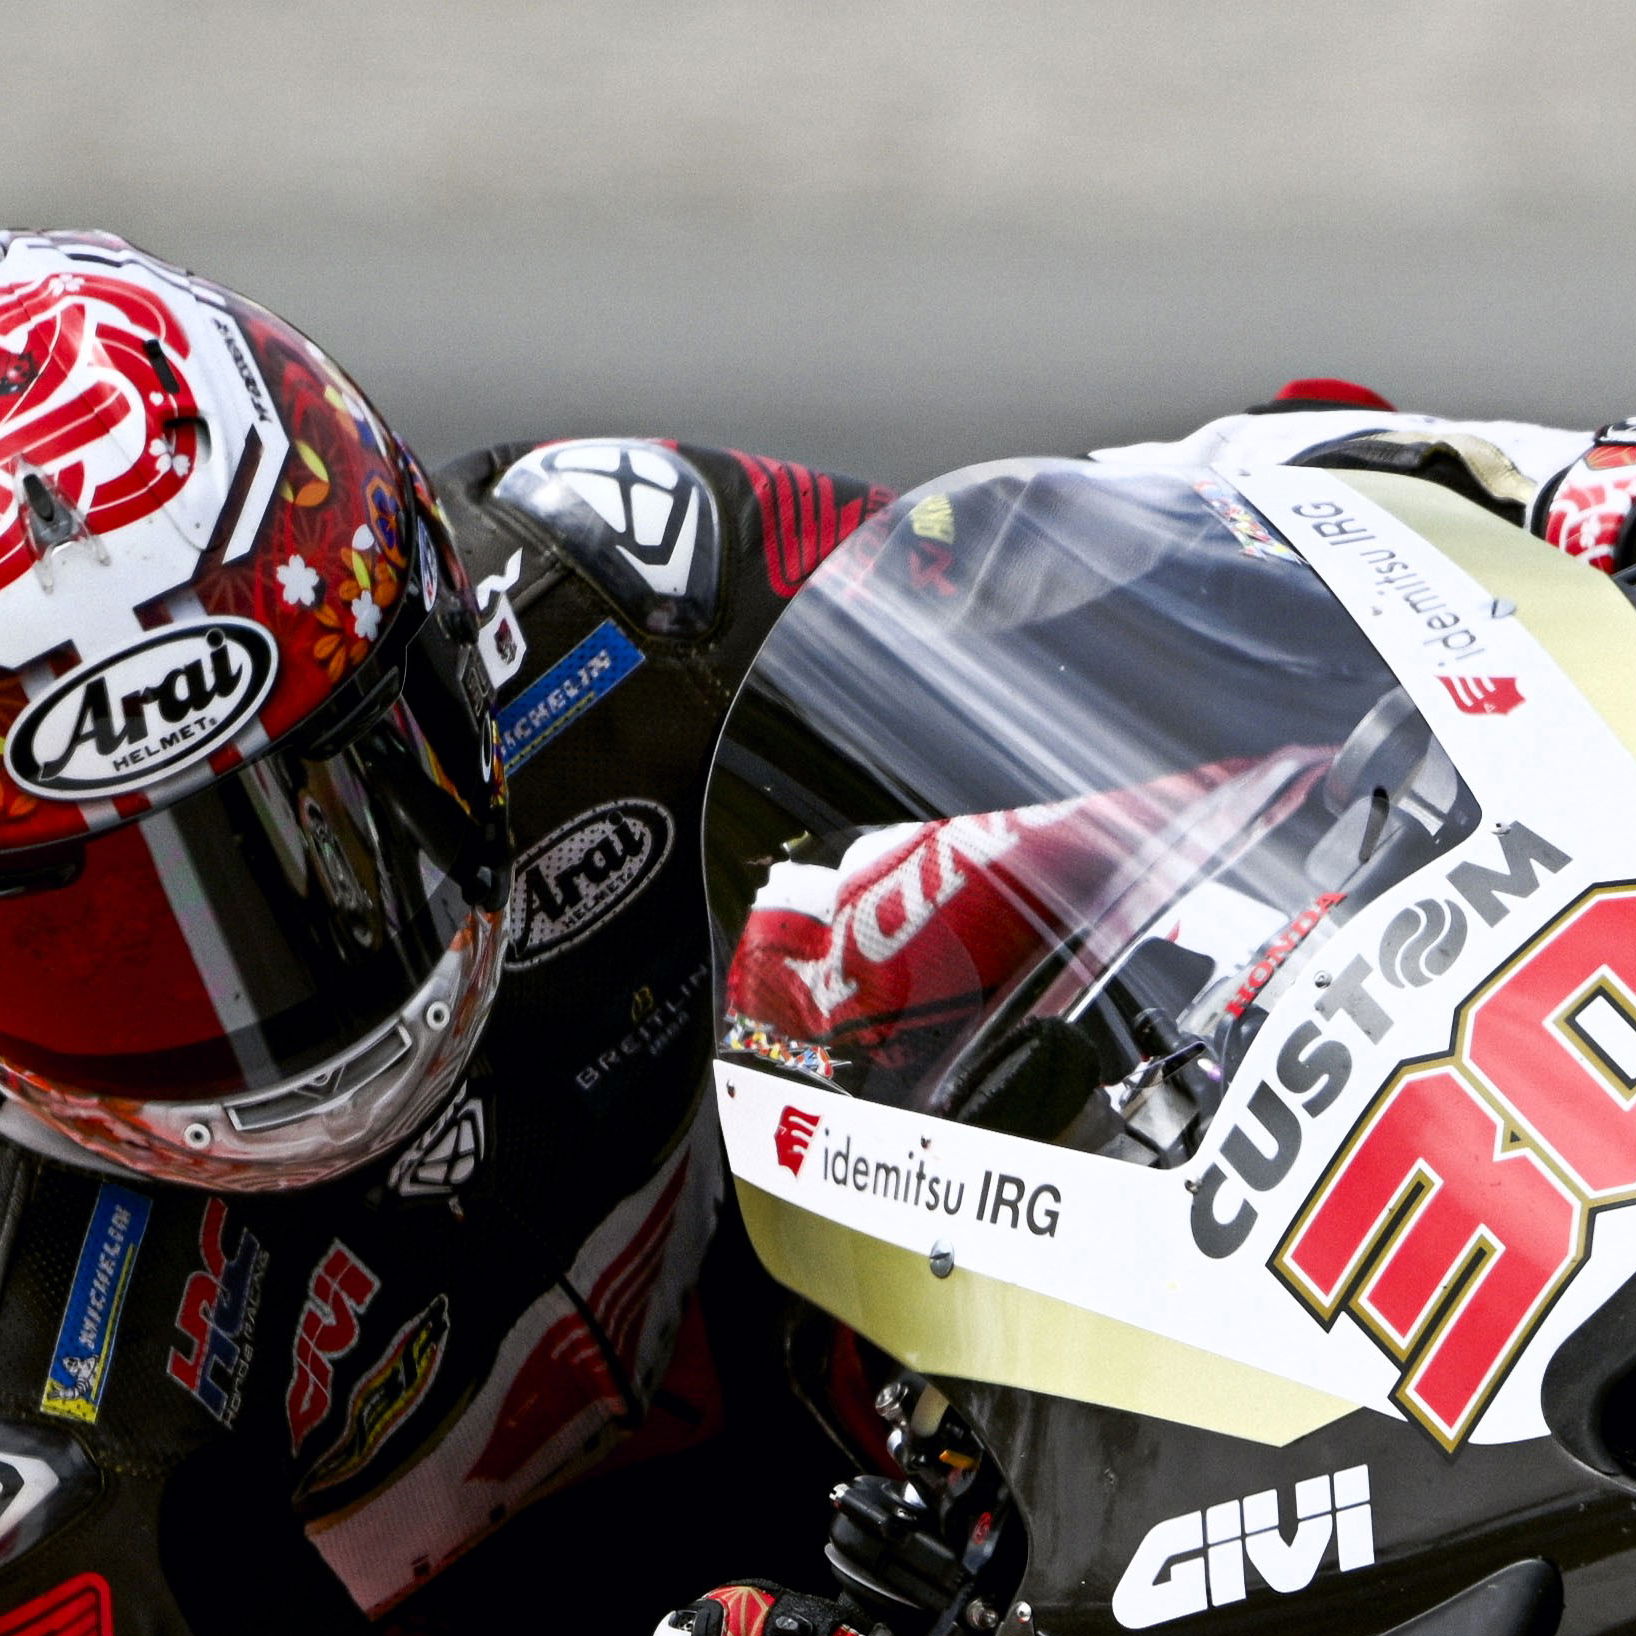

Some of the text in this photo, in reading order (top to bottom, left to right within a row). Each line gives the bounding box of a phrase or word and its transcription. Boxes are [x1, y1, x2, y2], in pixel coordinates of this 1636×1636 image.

[1291, 501, 1486, 668] idemitsu IRG
[39, 628, 243, 781] Arai
[113, 716, 208, 771] HELMET
[500, 649, 611, 757] ICHELIN
[513, 810, 646, 957] Arai
[1225, 891, 1347, 1018] HONDA
[574, 961, 709, 1091] BREITLIN
[1190, 820, 1572, 1259] CUSTOM
[822, 1130, 1062, 1237] idemitsu IRG
[78, 1203, 132, 1350] MICHELIN
[1112, 1464, 1375, 1629] GIVI
